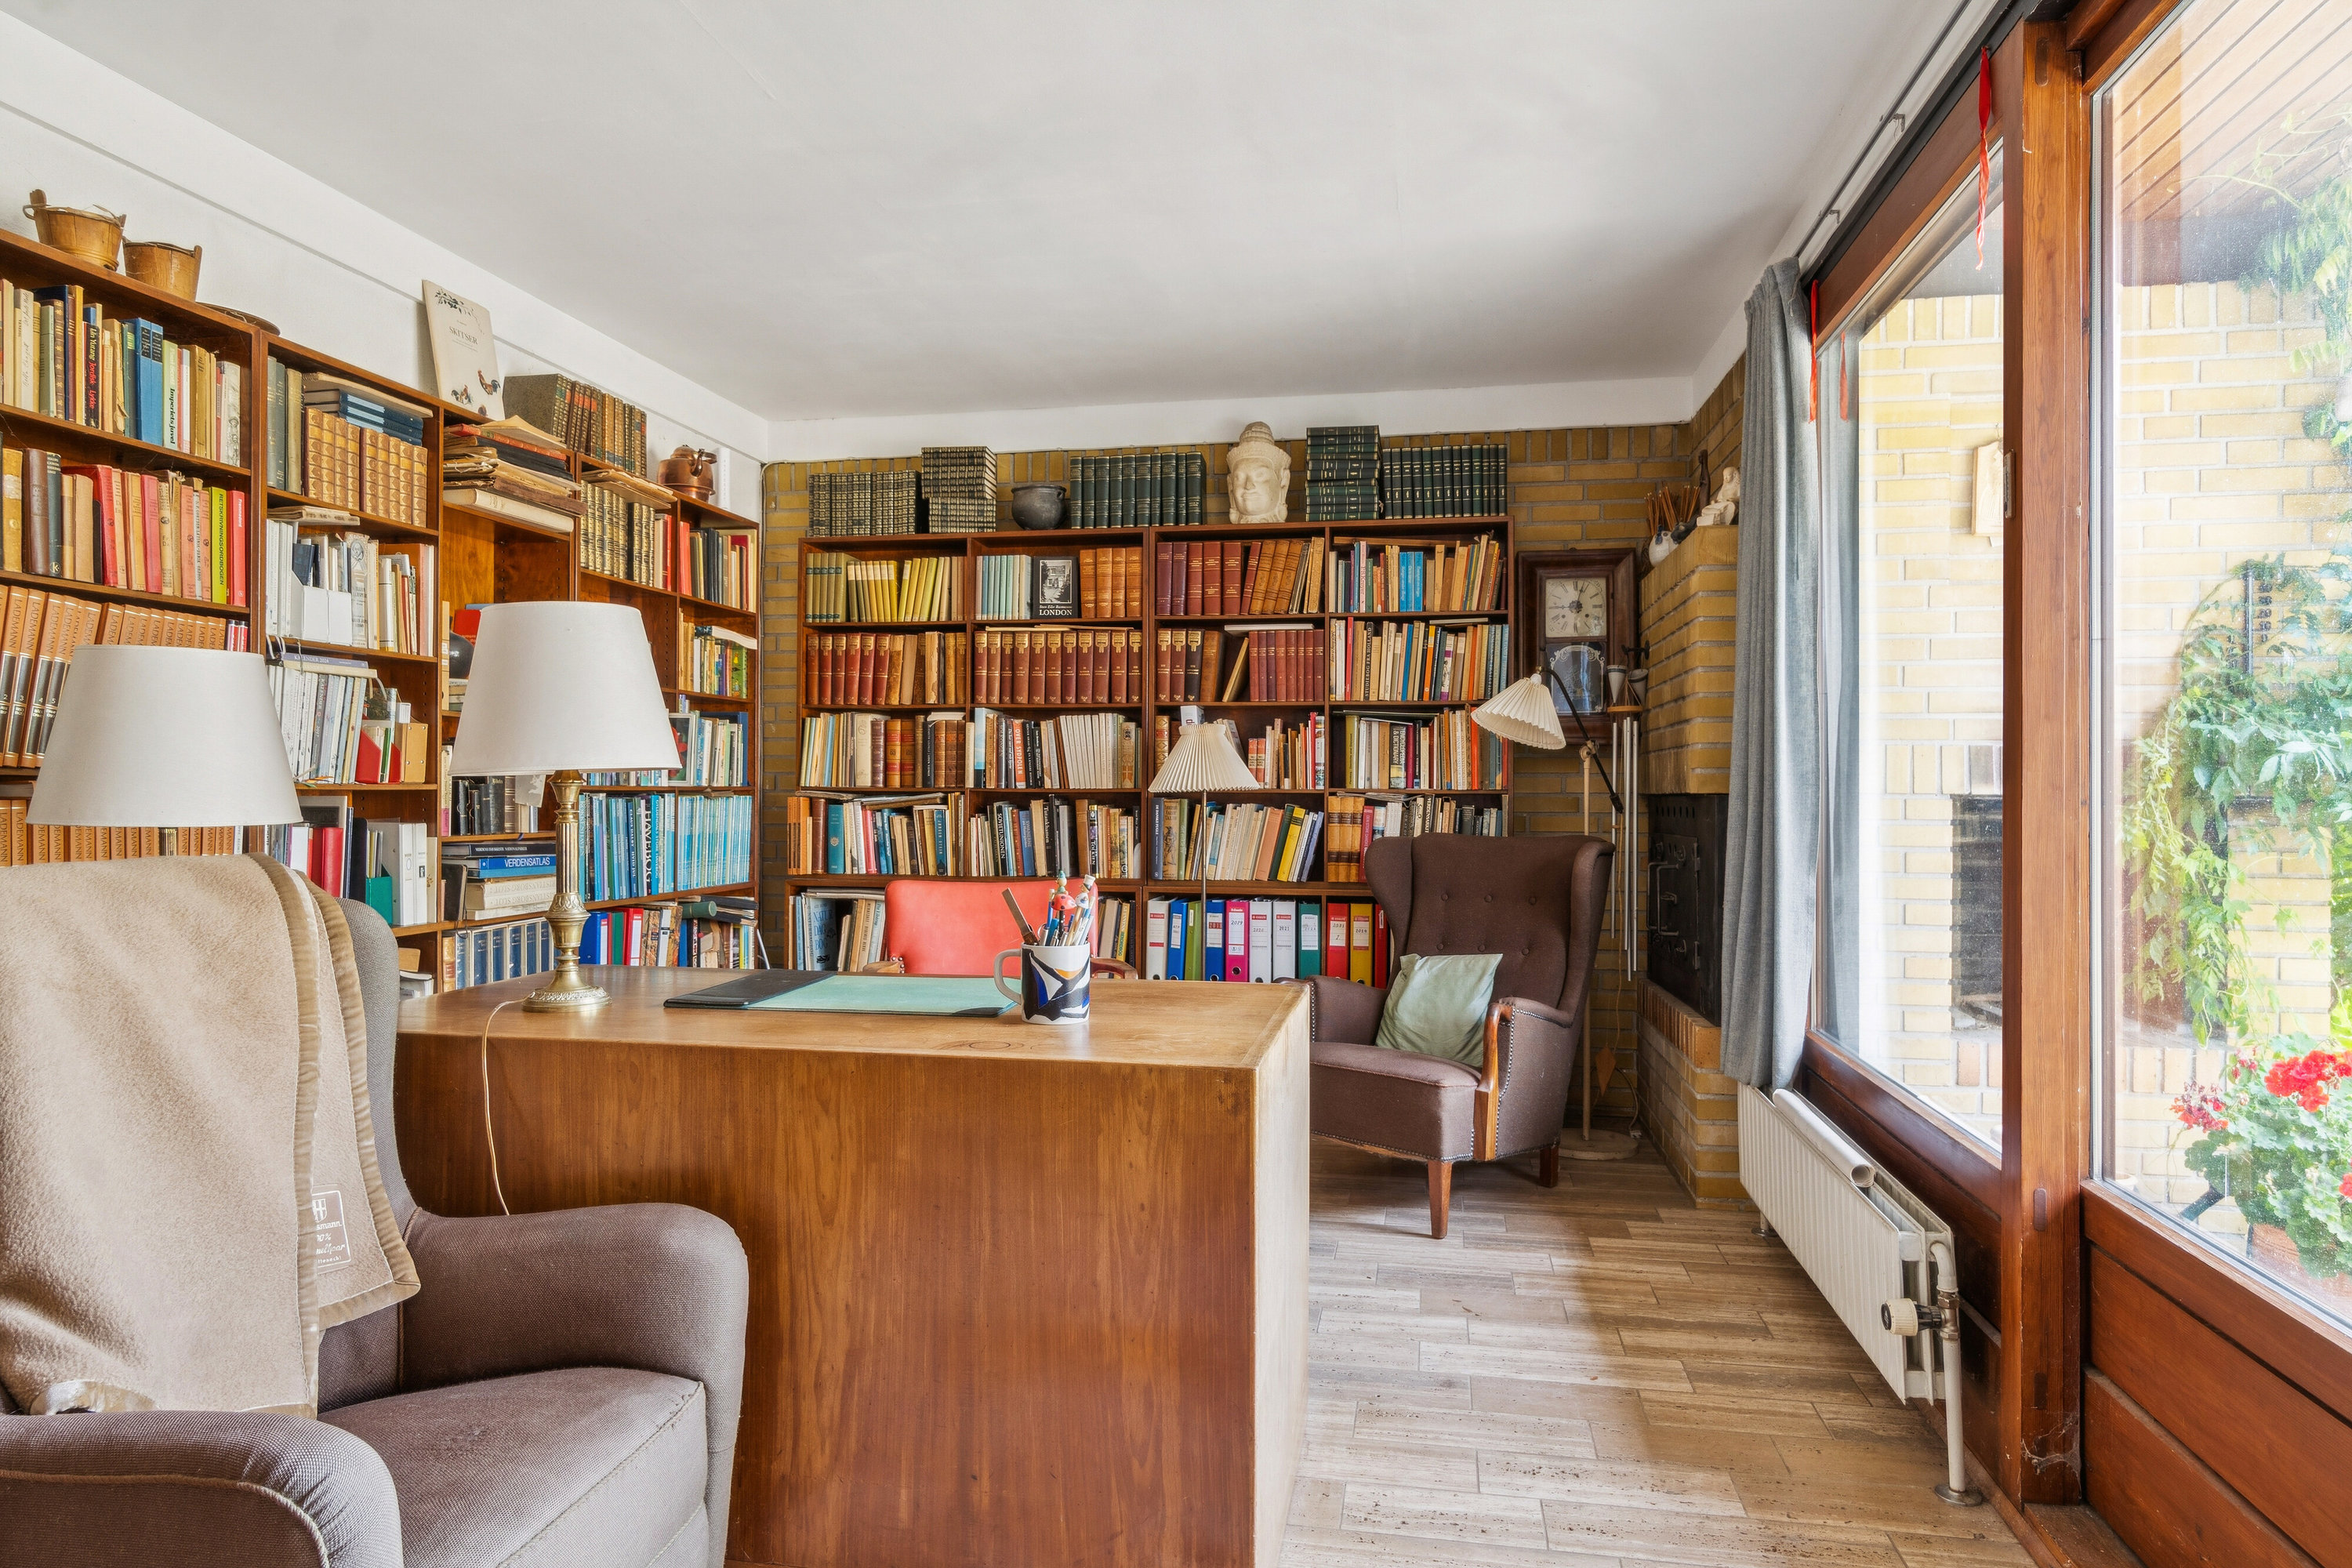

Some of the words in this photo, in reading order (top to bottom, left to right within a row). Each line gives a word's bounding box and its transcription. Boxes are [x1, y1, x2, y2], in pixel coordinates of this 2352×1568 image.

[448, 325, 478, 346] SKITSER
[9, 598, 23, 649] LADEMANN
[26, 602, 40, 651] LADEMANN
[46, 604, 61, 654] LADEMANN
[60, 606, 73, 655] LADEMANN
[16, 811, 24, 862] LADEMANN
[997, 813, 1006, 859] SOVJETUNIONEN
[504, 857, 550, 869] VERDENSATLAS
[813, 908, 833, 924] NATUR
[814, 923, 827, 938] DAG
[815, 938, 829, 952] BOG
